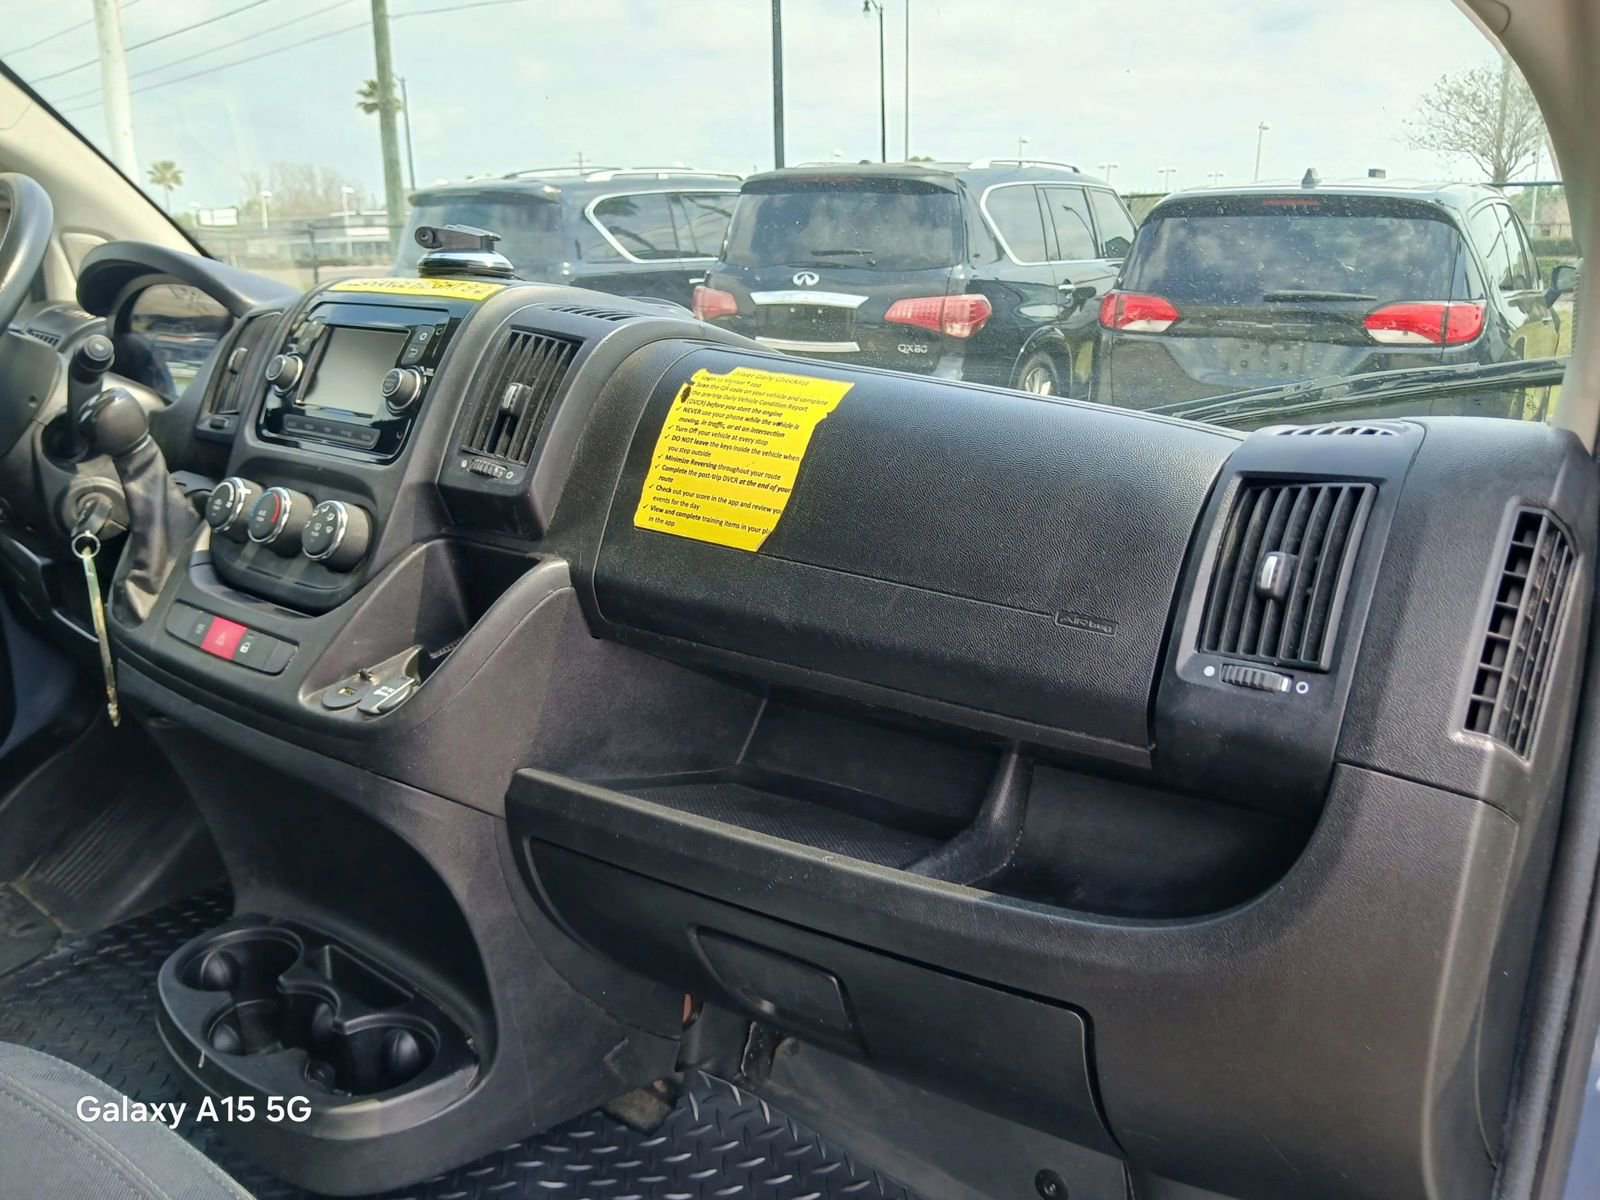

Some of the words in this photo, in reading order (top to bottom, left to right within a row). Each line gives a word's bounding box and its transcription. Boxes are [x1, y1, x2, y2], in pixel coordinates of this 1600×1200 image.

[755, 374, 774, 382] Daily
[776, 376, 810, 386] Checklist
[701, 391, 722, 400] pre-trip
[723, 393, 737, 402] Daily
[738, 395, 758, 404] Vehicle
[759, 399, 787, 408] Condition
[787, 403, 808, 412] Report
[766, 391, 787, 399] vehicle
[787, 394, 801, 402] and
[800, 397, 828, 406] complete
[682, 407, 702, 415] NEVER
[711, 411, 725, 420] your
[725, 412, 744, 422] phone
[744, 415, 761, 424] while
[686, 399, 706, 407] (DVCR)
[706, 401, 724, 410] before
[725, 404, 736, 412] you
[751, 406, 762, 414] the
[762, 409, 783, 418] engine
[679, 416, 700, 426] moving,
[707, 420, 726, 429] traffic,
[750, 427, 785, 437] intersection
[711, 431, 731, 440] vehicle
[738, 436, 754, 444] every
[754, 438, 768, 446] stop
[679, 446, 690, 454] step
[691, 448, 711, 457] outside
[681, 436, 694, 444] NOT
[693, 438, 709, 447] leave
[709, 440, 719, 448] the
[720, 441, 732, 451] keys
[732, 444, 750, 453] inside
[750, 447, 761, 455] the
[761, 449, 782, 458] vehicle
[783, 453, 800, 461] when
[665, 454, 690, 464] Minimize
[690, 458, 718, 470] Reversing
[718, 463, 750, 475] throughout
[764, 472, 781, 480] route
[658, 475, 674, 483] route
[661, 464, 687, 475] Complete
[687, 468, 698, 476] the
[697, 471, 722, 481] post-trip
[722, 474, 738, 483] DVCR
[746, 478, 757, 486] the
[757, 481, 769, 489] end
[769, 483, 778, 492] of
[777, 486, 792, 494] your
[652, 495, 671, 504] events
[671, 498, 680, 506] for
[689, 503, 700, 511] day
[655, 484, 671, 493] Check
[682, 490, 695, 498] your
[695, 493, 711, 501] score
[717, 496, 728, 504] the
[728, 499, 740, 507] app
[740, 501, 752, 509] and
[752, 504, 772, 513] review
[650, 504, 664, 513] View
[664, 508, 676, 516] and
[675, 511, 701, 521] complete
[701, 515, 723, 527] training
[723, 520, 741, 529] items
[655, 516, 664, 524] the
[664, 519, 676, 527] app
